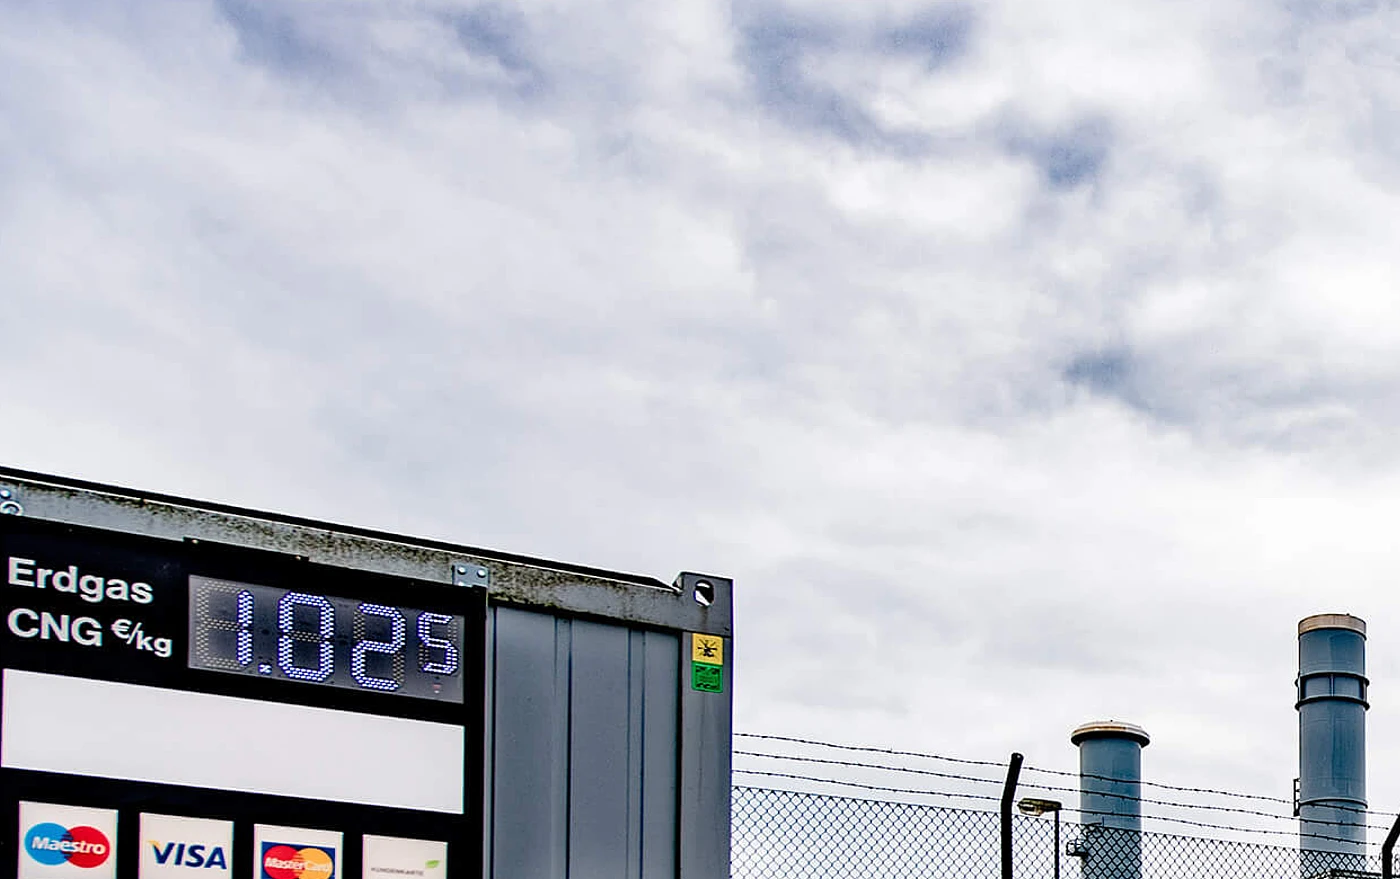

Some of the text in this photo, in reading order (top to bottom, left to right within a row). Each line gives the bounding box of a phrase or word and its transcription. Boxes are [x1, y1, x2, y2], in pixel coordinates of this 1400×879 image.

[8, 555, 154, 604] Erdgas
[7, 607, 173, 658] CNG €/kg
[31, 836, 106, 856] Maestro
[148, 840, 228, 870] VISA
[264, 856, 332, 873] MasterCard
